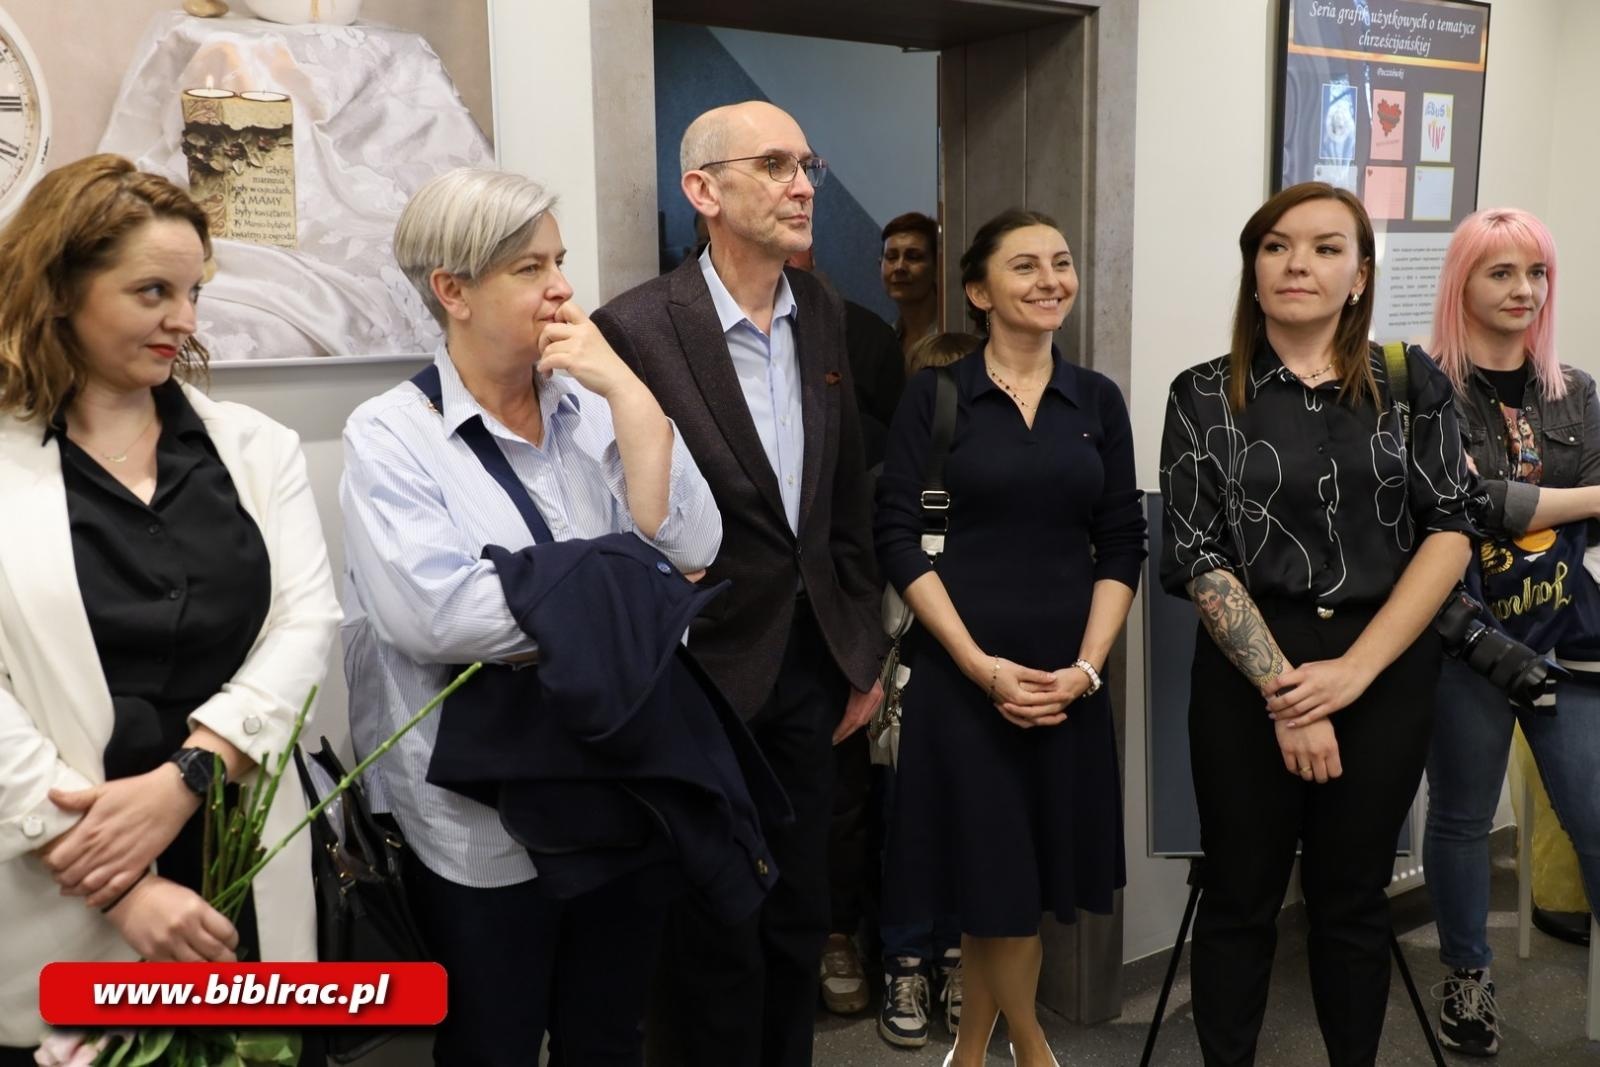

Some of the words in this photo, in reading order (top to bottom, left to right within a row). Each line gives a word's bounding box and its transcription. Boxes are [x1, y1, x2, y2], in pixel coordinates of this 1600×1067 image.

[1310, 2, 1336, 17] Seria
[1336, 4, 1370, 25] grafik
[1371, 9, 1427, 32] użytkowych
[1429, 20, 1435, 30] o
[1436, 21, 1476, 38] tematyce
[1358, 30, 1432, 57] chrześcijańskiej
[248, 196, 282, 206] MAMY
